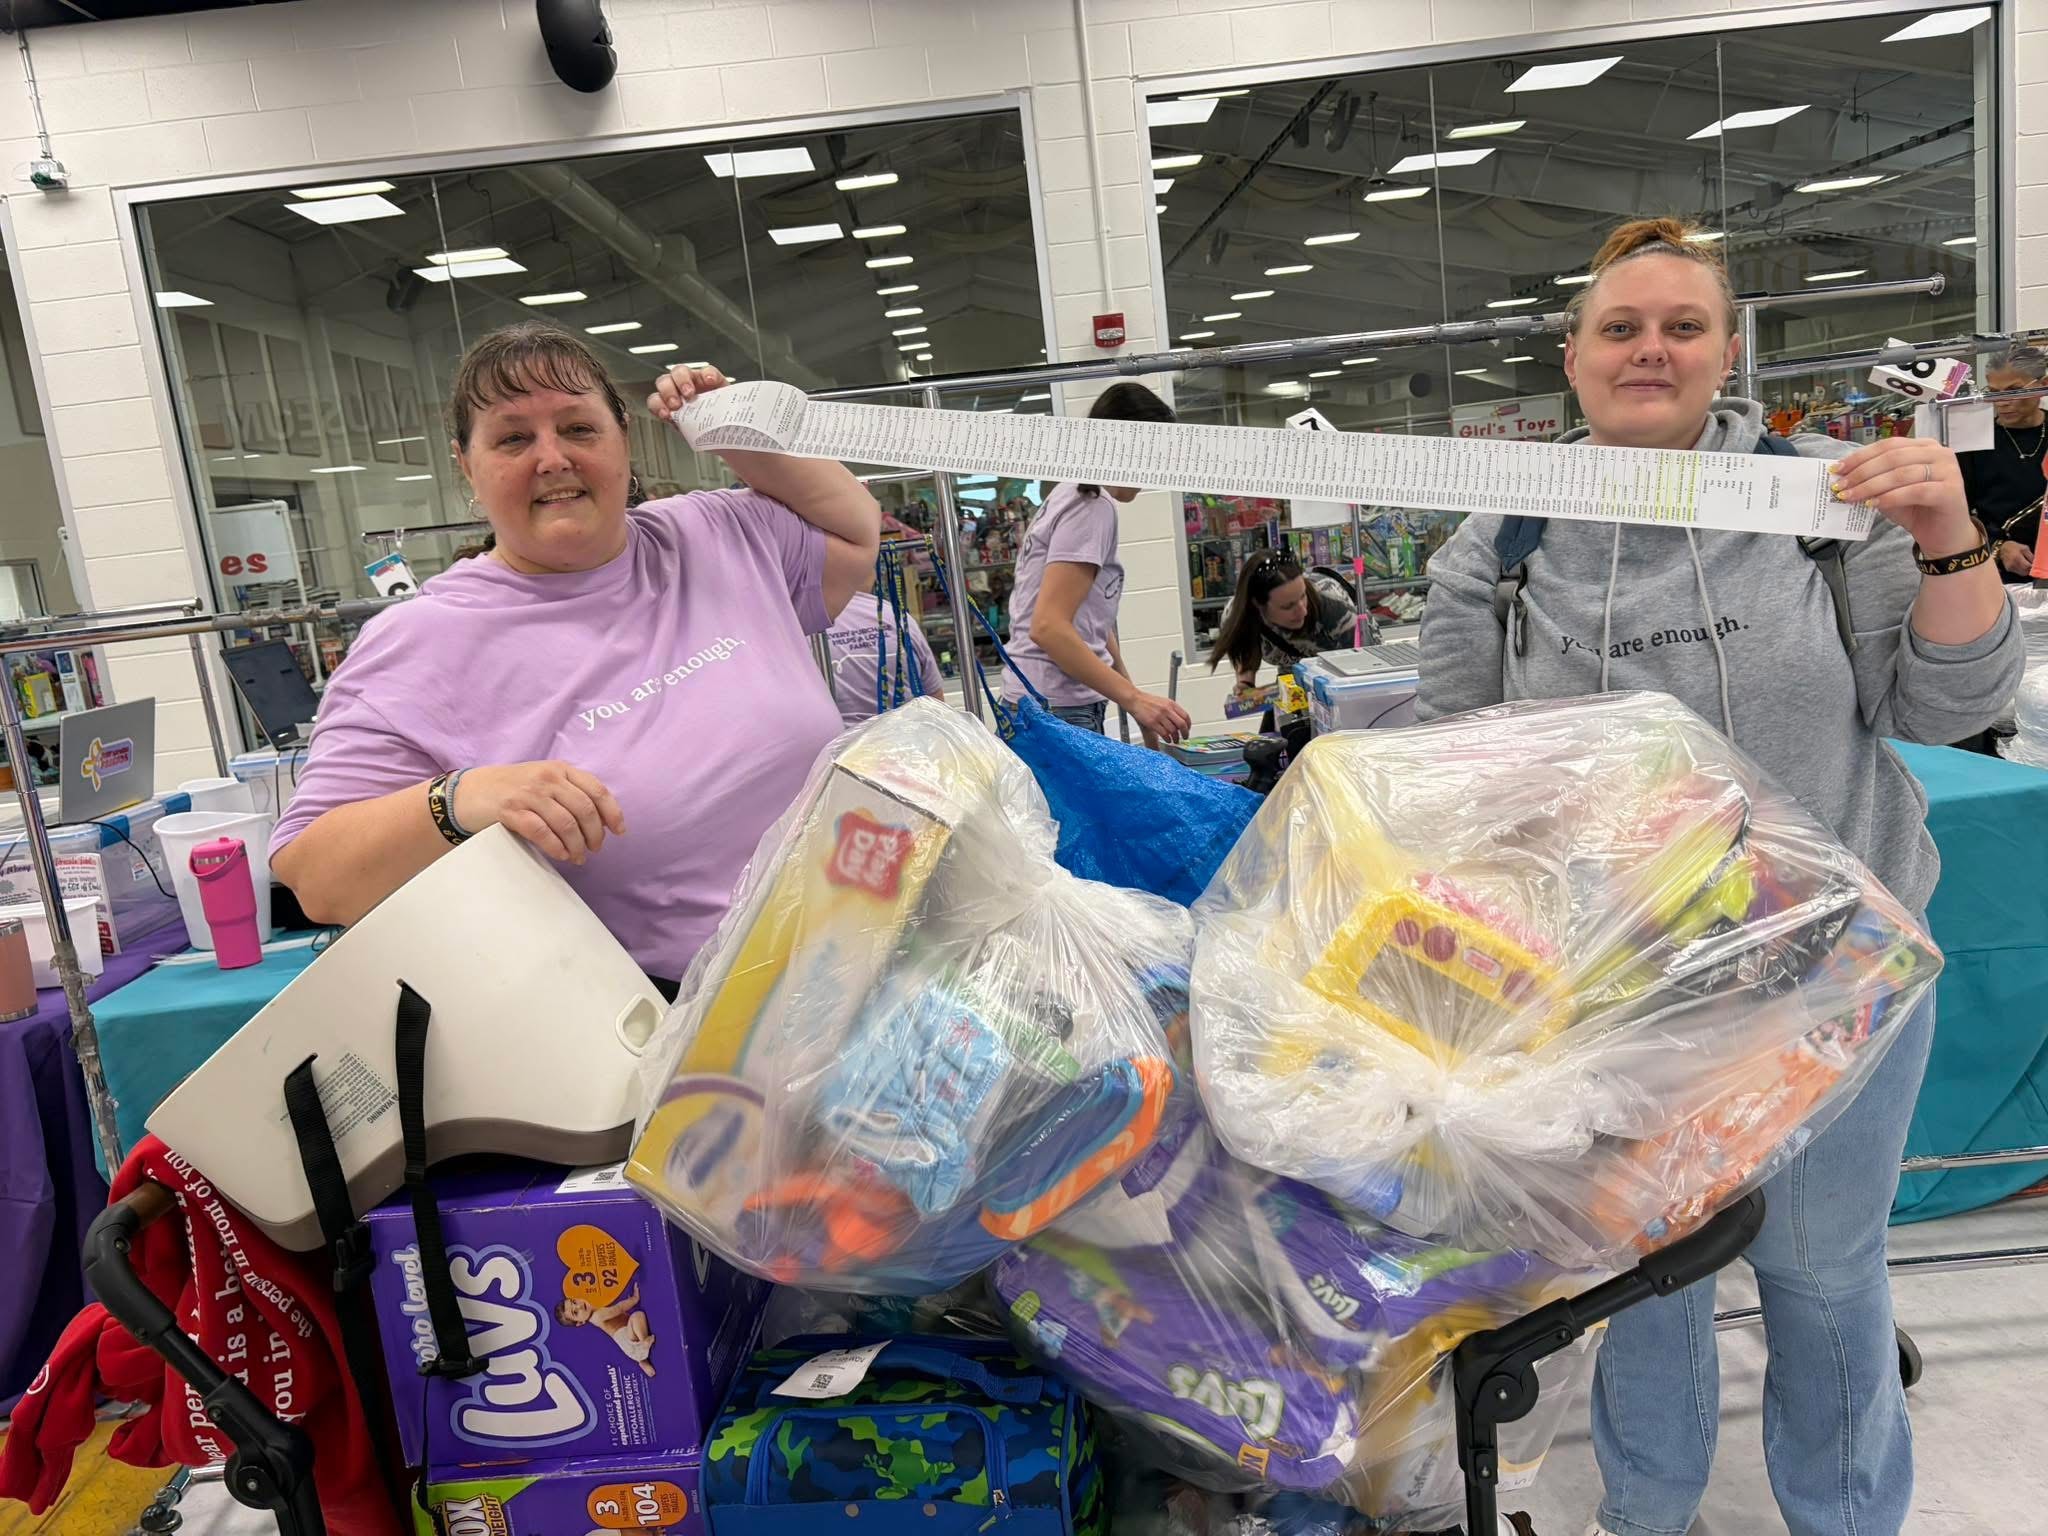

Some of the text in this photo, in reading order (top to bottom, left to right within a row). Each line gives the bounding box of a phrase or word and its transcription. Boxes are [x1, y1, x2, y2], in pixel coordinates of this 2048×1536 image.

[1886, 377, 1924, 397] 8
[1513, 418, 1557, 433] Toys
[1961, 548, 1989, 568] VIP
[1609, 637, 1644, 659] are
[578, 701, 631, 732] you
[431, 796, 445, 824] VIP
[367, 1099, 395, 1124] WARNING
[164, 1149, 197, 1181] you
[184, 1177, 212, 1199] of
[596, 1243, 607, 1267] DIAPERS
[393, 1247, 428, 1313] level
[572, 1271, 596, 1287] 3
[601, 1268, 619, 1288] 92
[226, 1304, 244, 1324] a
[291, 1311, 314, 1338] the
[218, 1333, 247, 1363] is
[276, 1368, 307, 1422] you
[603, 1388, 612, 1400] OF
[606, 1402, 618, 1435] CHOICE
[612, 1398, 629, 1446] experienced
[623, 1375, 641, 1445] HYPOALLERGENIC
[449, 1498, 491, 1536] OX
[597, 1500, 620, 1515] 3
[632, 1482, 657, 1526] 104
